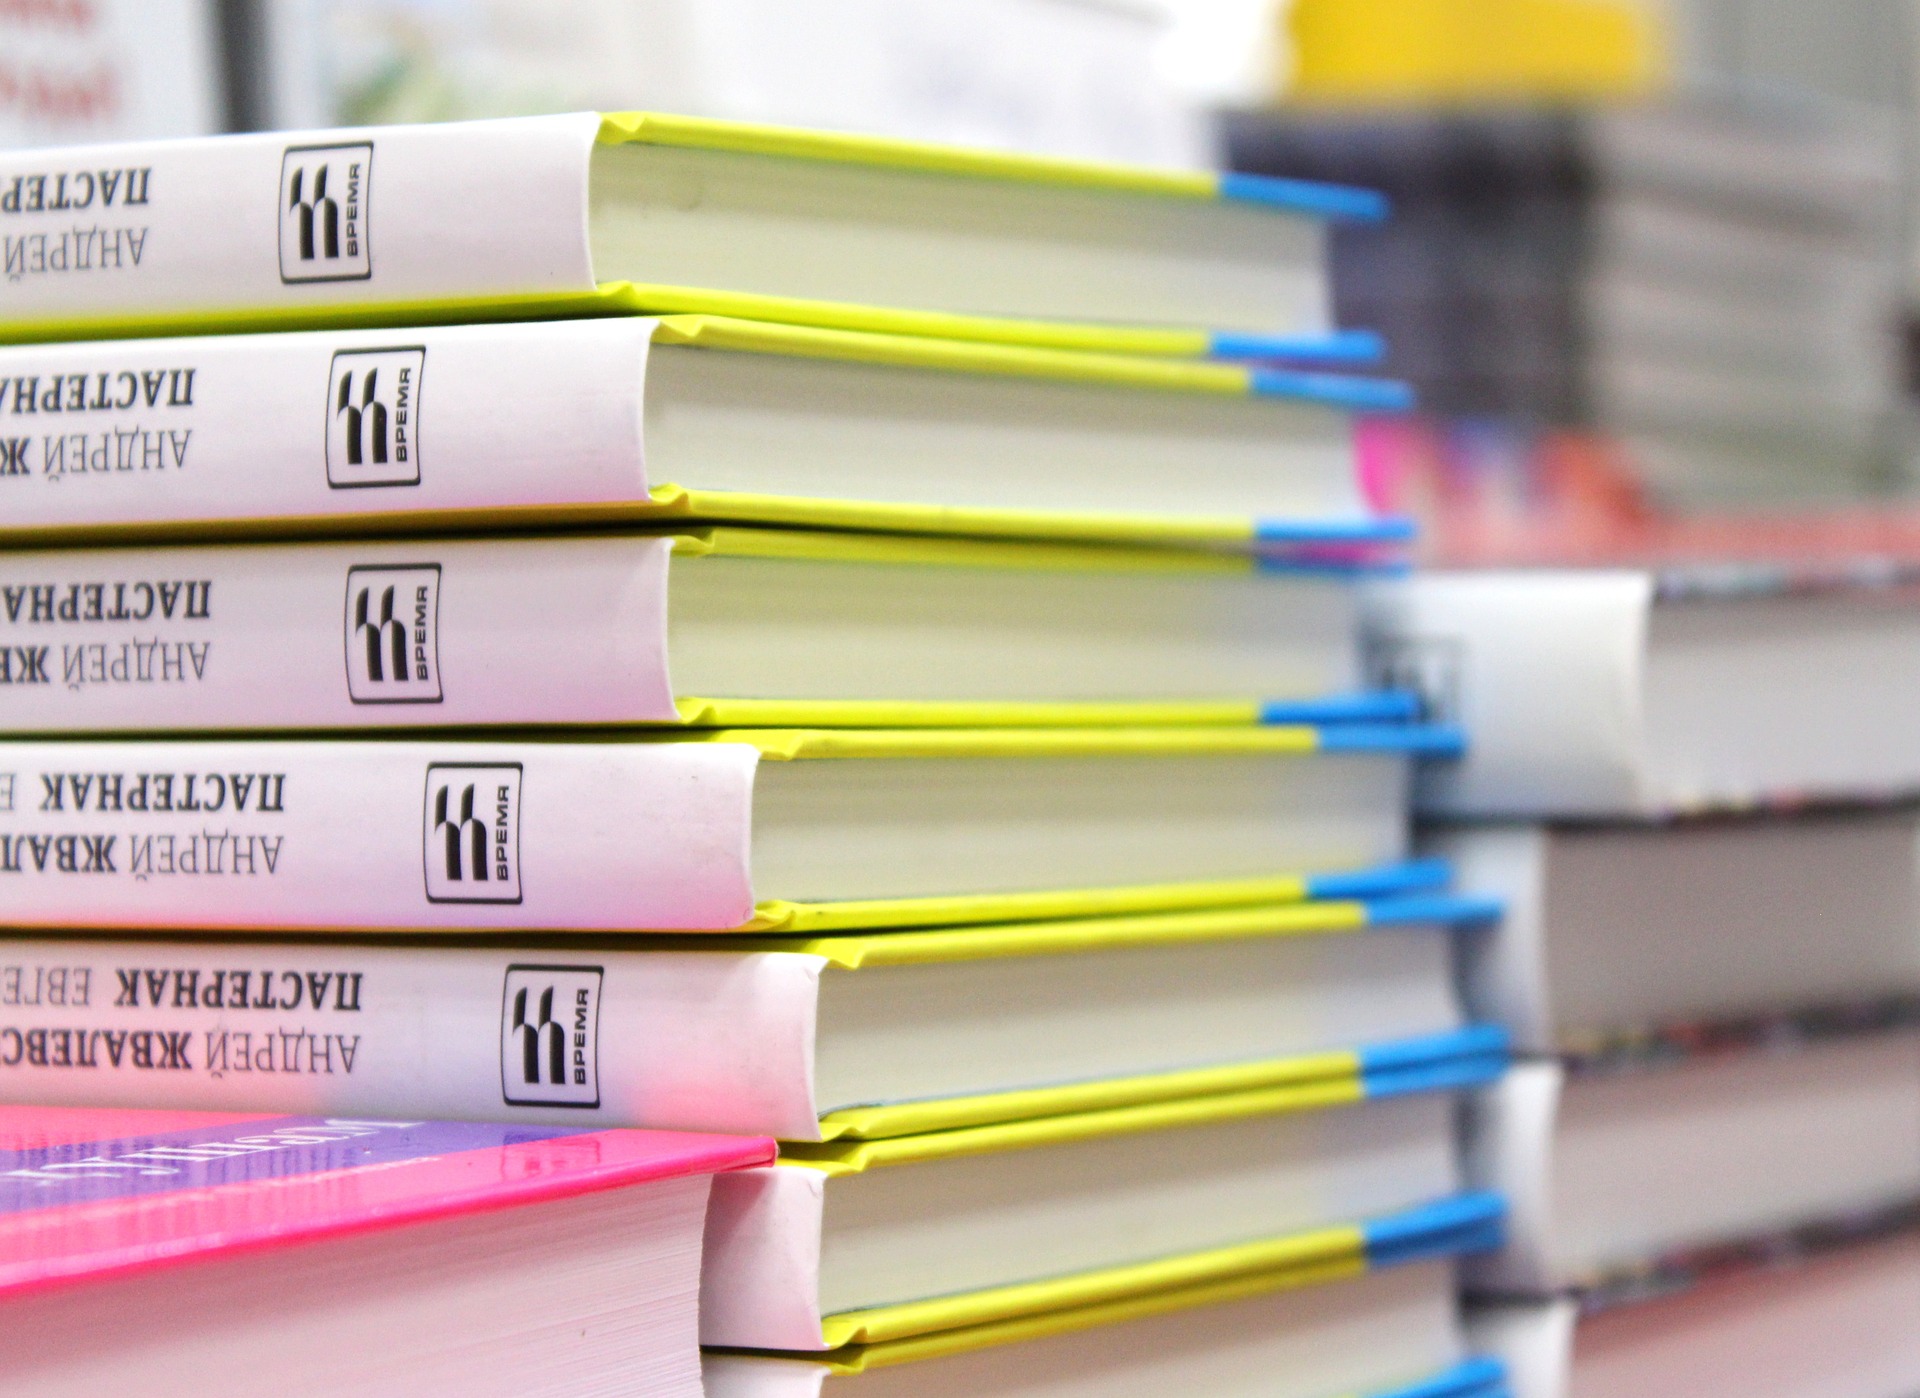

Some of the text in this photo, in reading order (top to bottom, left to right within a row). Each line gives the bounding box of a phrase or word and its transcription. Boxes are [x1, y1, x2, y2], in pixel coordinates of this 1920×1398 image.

[3, 167, 152, 213] ПАСТЕР
[346, 162, 361, 257] ВРЕМЯ
[4, 224, 149, 282] АНДРЕЙ
[395, 367, 411, 462] ВРЕМЯ
[43, 424, 193, 481] АНДРЕЙ
[2, 580, 212, 624] ПАСТЕРНА
[415, 585, 429, 681] ВРЕМЯ
[63, 636, 211, 691] АНДРЕЙ
[40, 773, 286, 813] ПАСТЕРНАК
[0, 827, 284, 881] АНДРЕЙ ЖВАЛ
[496, 785, 510, 882] ВРЕМЯ
[3, 966, 363, 1012] ПАСТЕРНАК ЕВГЕ
[2, 1027, 361, 1079] АНДРЕЙ ЖВАЛЕВС
[573, 988, 589, 1085] ВРЕМЯ
